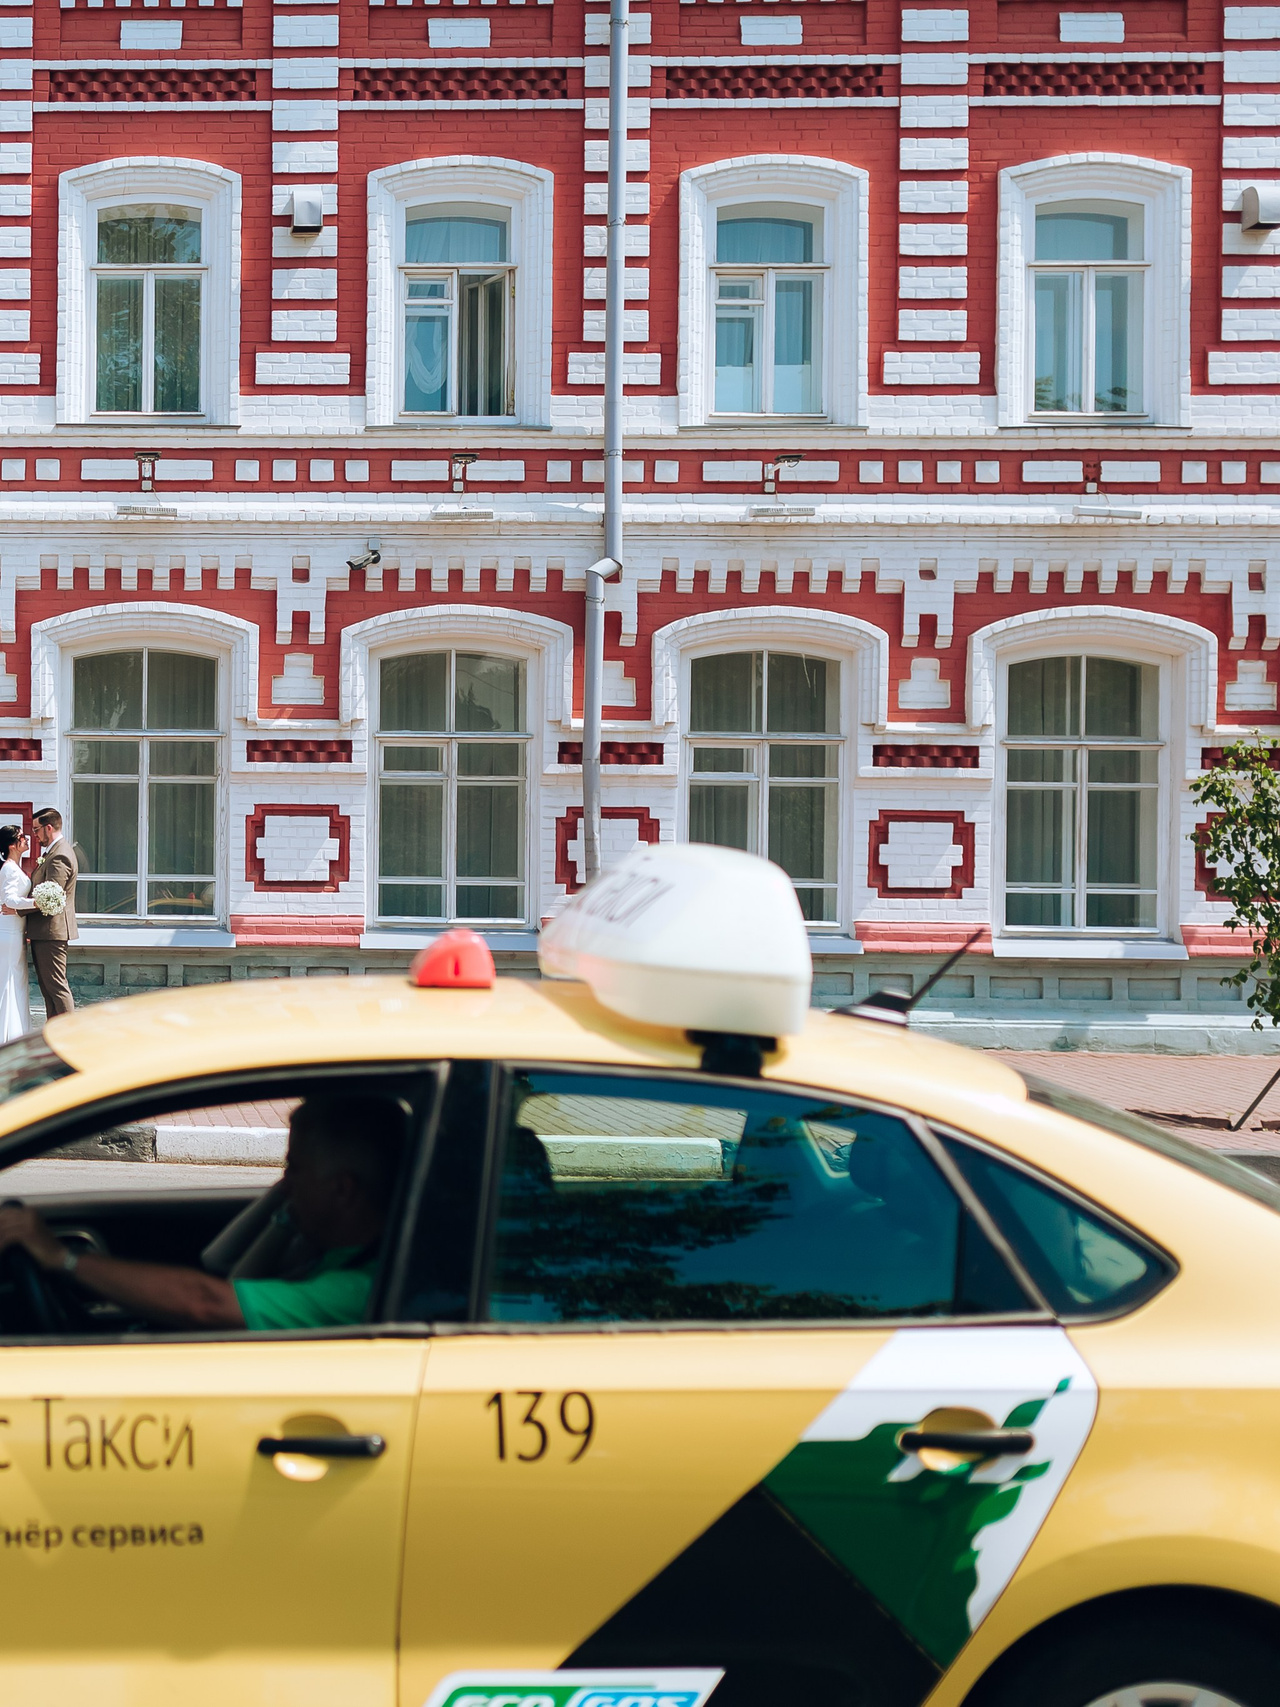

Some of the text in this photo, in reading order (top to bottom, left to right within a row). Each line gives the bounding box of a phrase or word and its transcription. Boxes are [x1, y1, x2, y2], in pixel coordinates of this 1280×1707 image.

[32, 1395, 195, 1472] Такси
[486, 1390, 595, 1465] 139
[71, 1522, 205, 1553] сервиса
